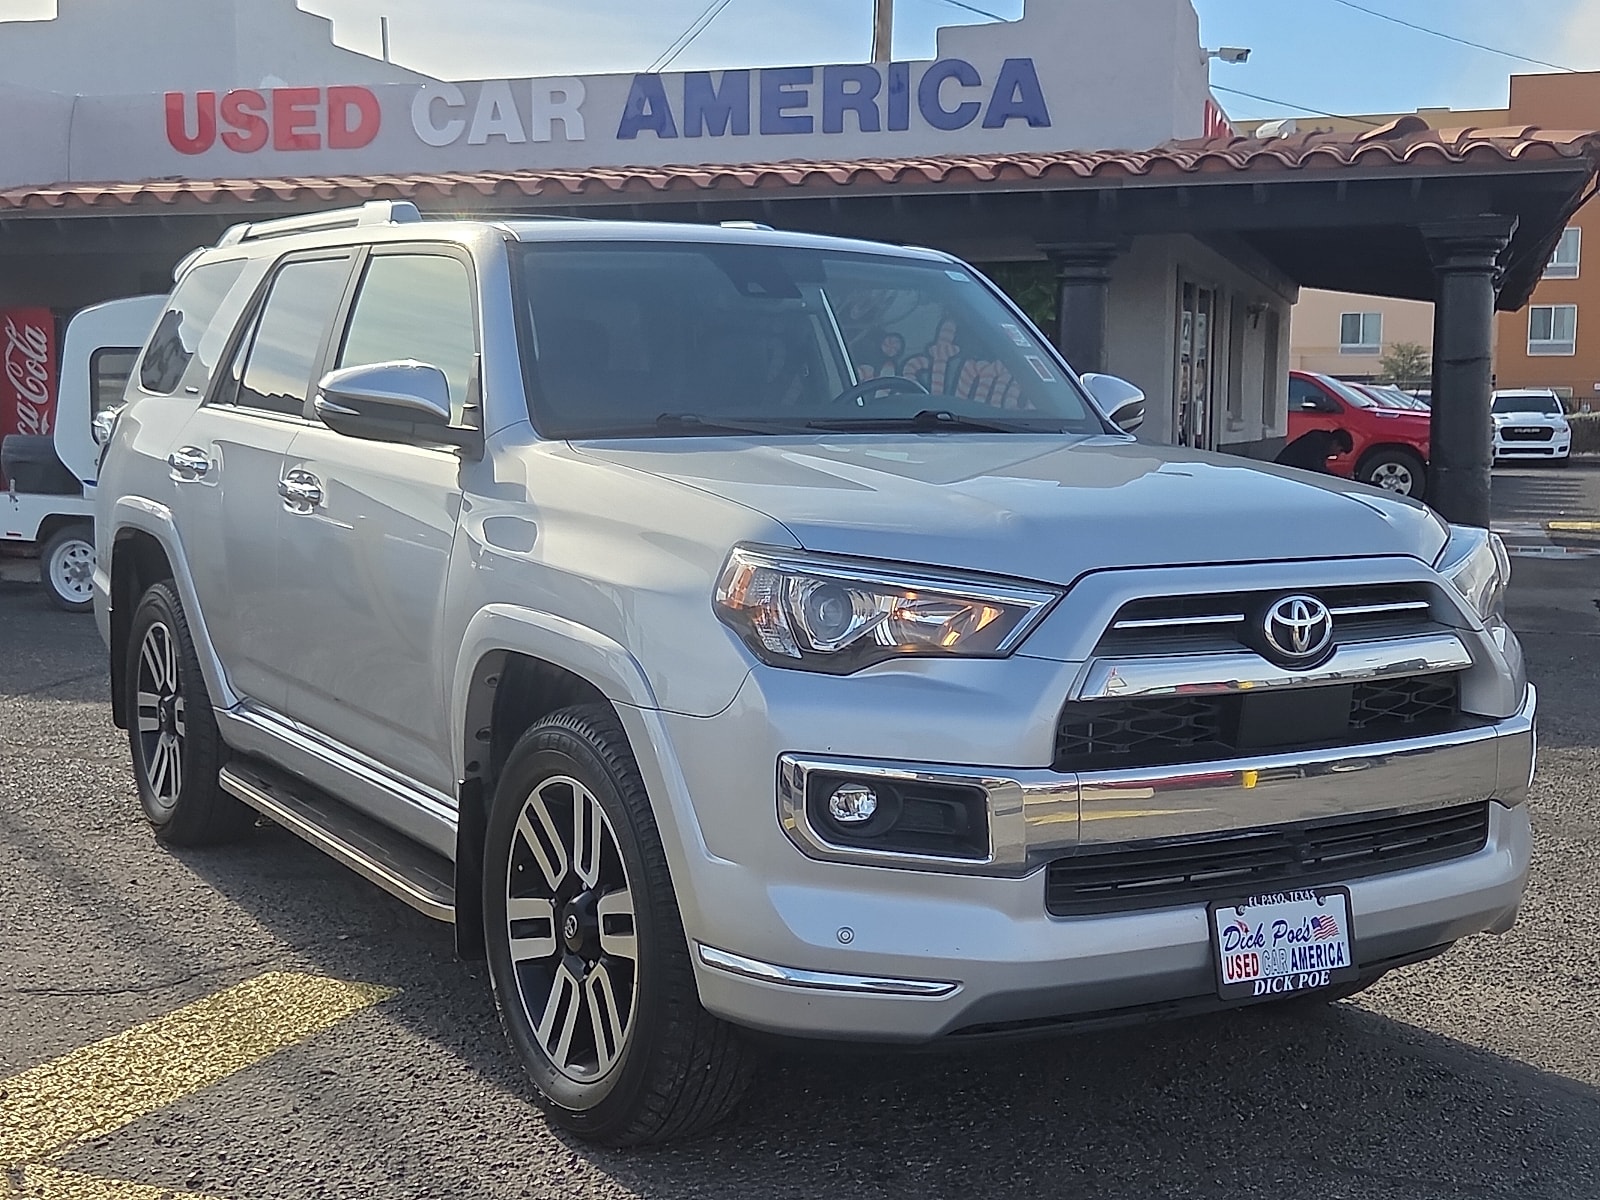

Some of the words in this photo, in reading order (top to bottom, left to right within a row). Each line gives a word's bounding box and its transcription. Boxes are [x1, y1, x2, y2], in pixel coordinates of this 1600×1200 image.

[165, 85, 381, 155] USED
[411, 76, 586, 147] CAR
[616, 58, 1052, 140] AMERICA
[1289, 890, 1315, 903] TEXAS
[1223, 922, 1266, 952] Dick
[1272, 917, 1312, 947] Poe's
[1226, 954, 1259, 980] USED
[1261, 949, 1289, 976] CAR
[1291, 942, 1344, 971] AMERICA
[1253, 975, 1296, 996] DICK
[1298, 970, 1331, 988] POE
